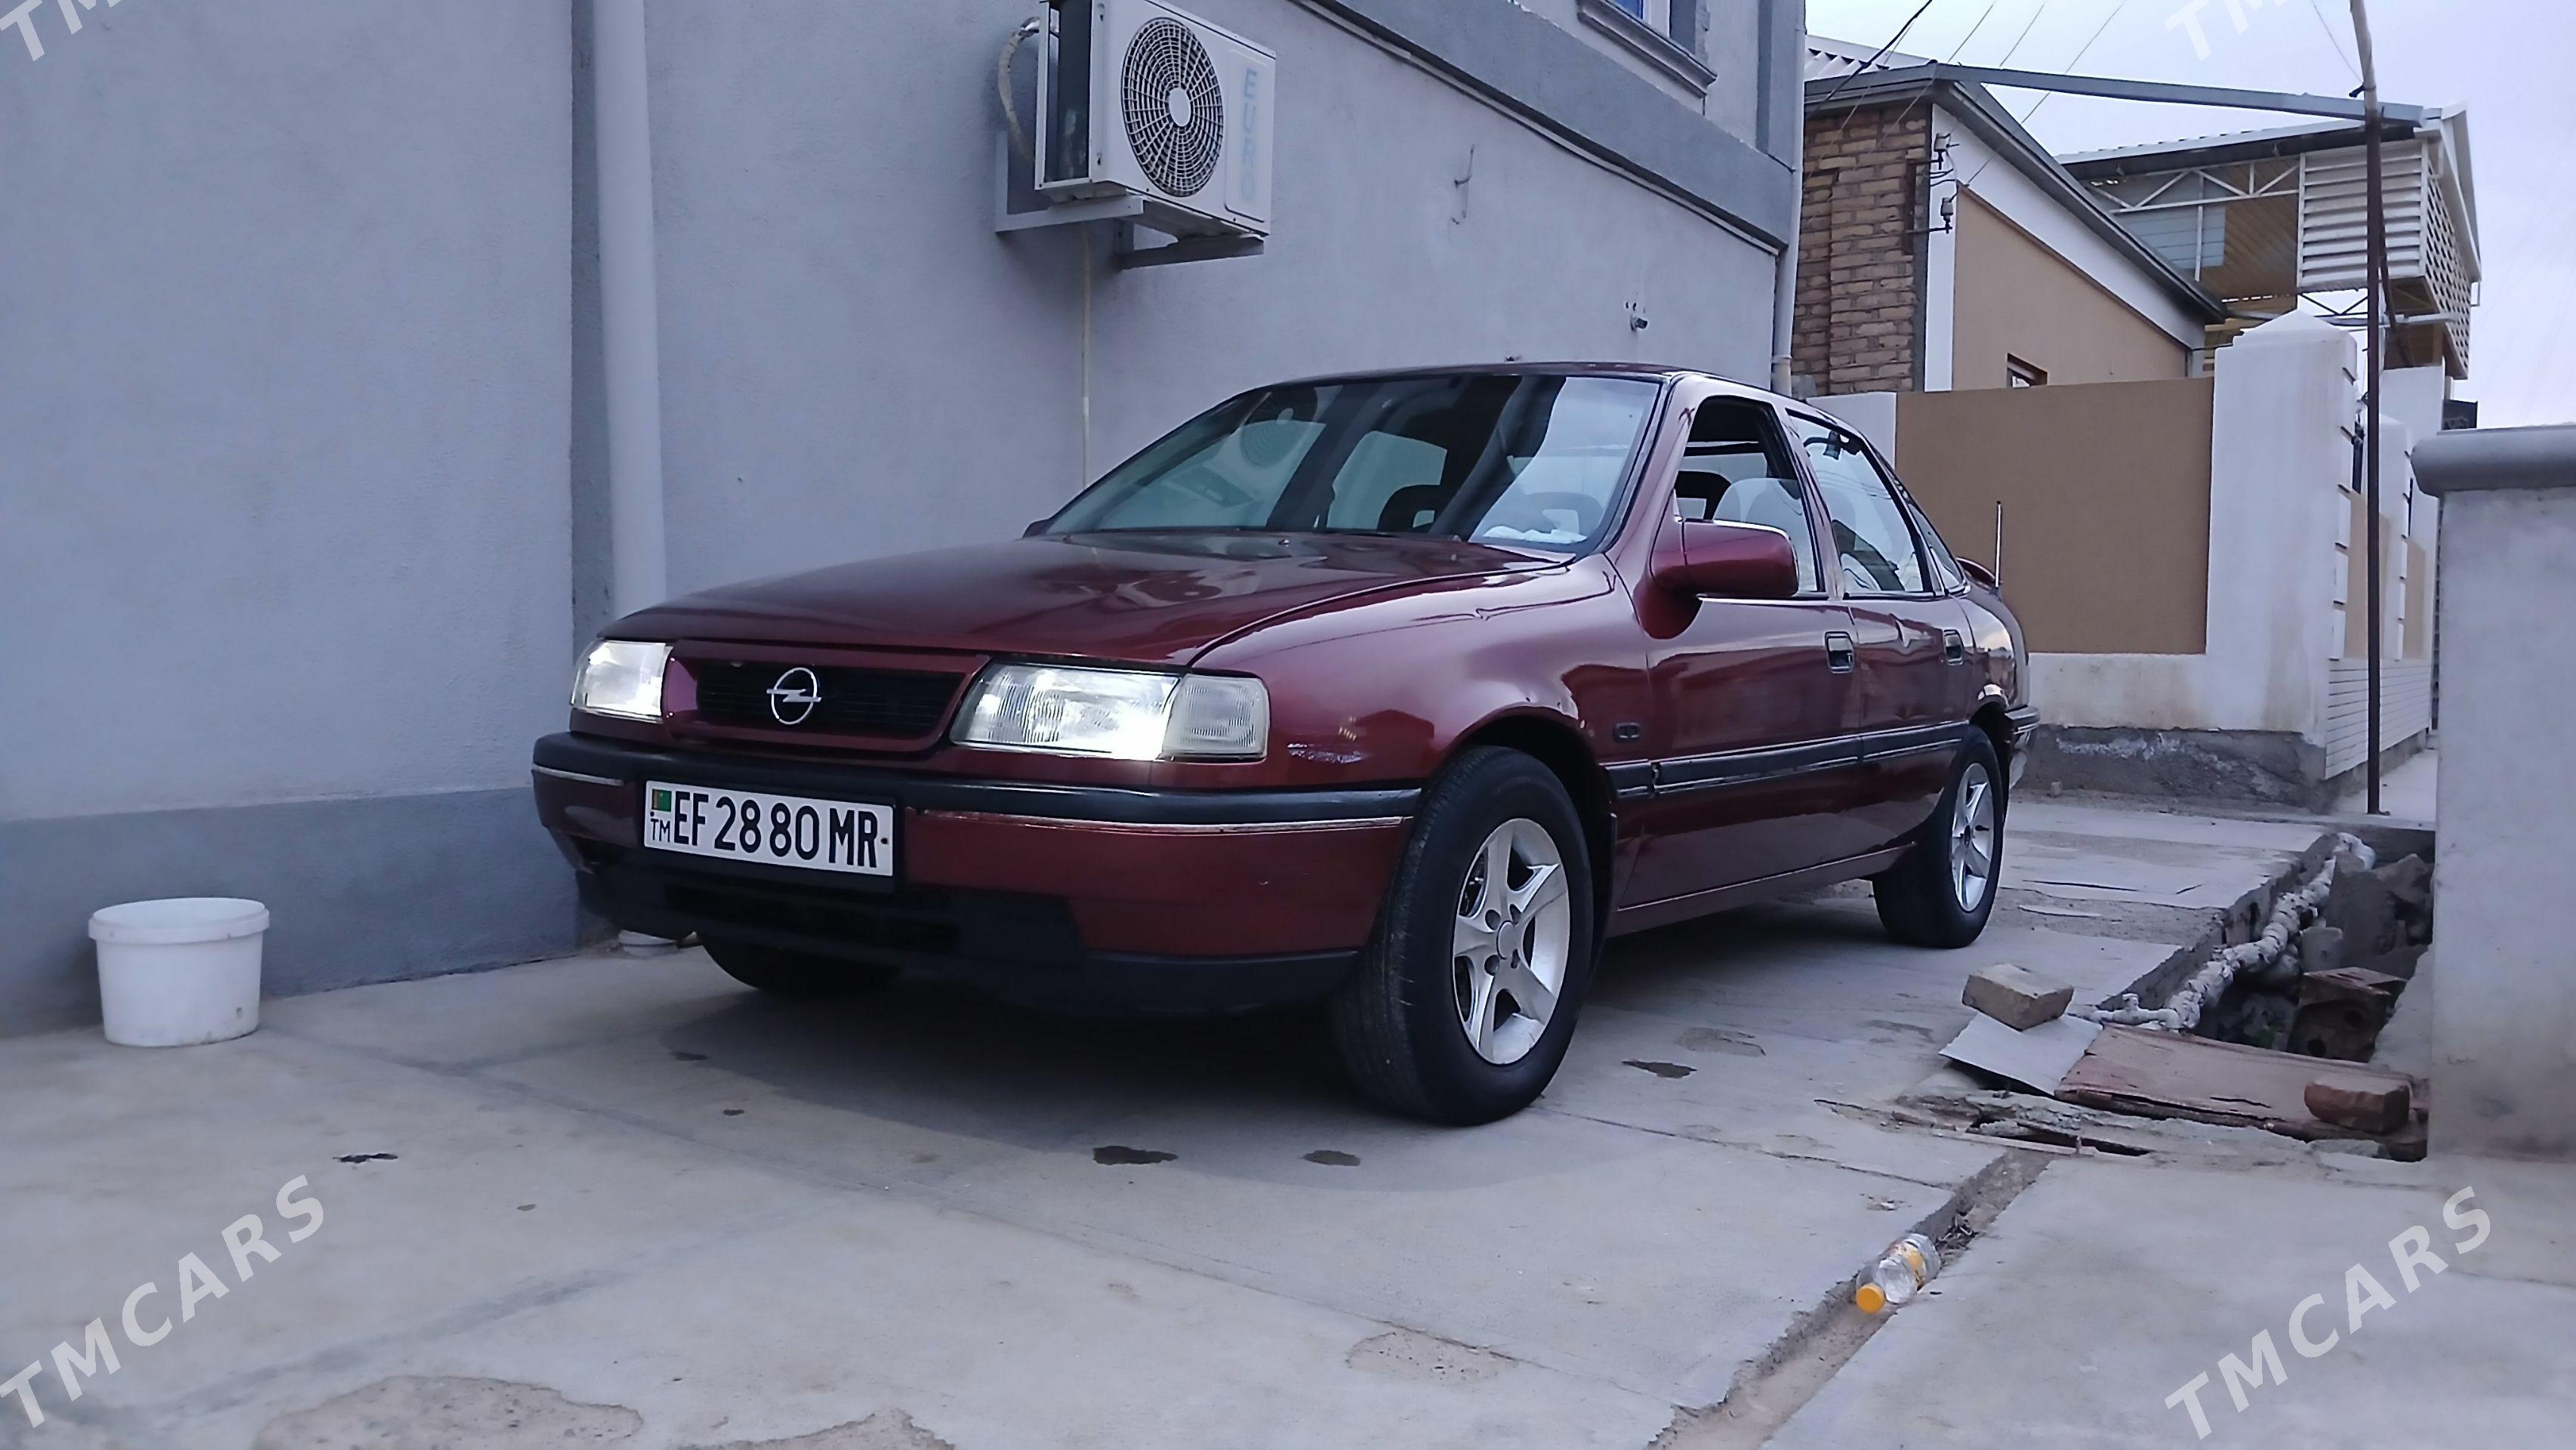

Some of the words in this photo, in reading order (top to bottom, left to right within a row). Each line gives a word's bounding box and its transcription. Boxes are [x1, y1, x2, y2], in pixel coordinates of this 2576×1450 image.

[650, 818, 670, 843] TM
[674, 791, 709, 846] EF
[828, 807, 877, 868] MR
